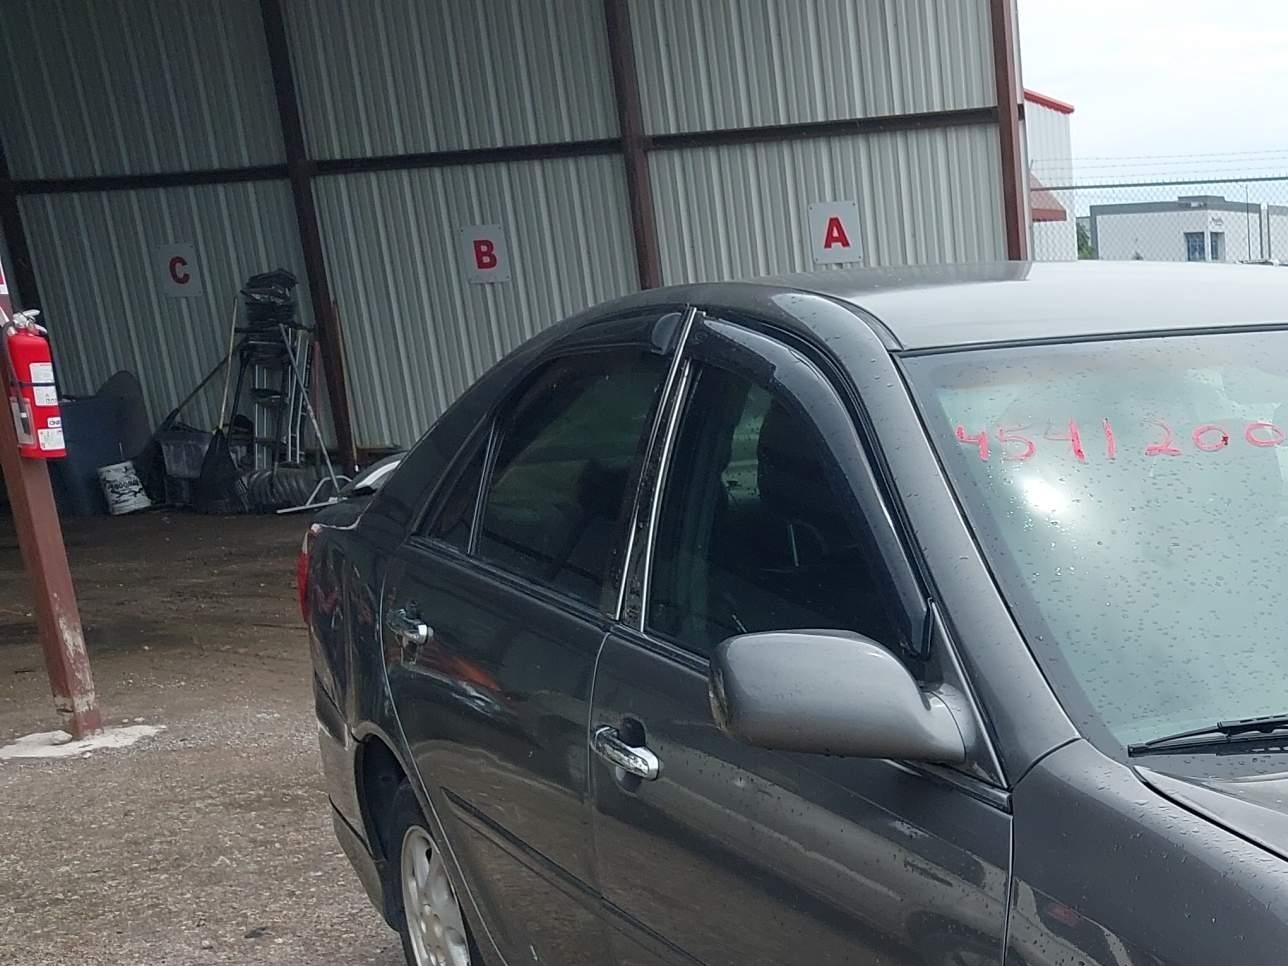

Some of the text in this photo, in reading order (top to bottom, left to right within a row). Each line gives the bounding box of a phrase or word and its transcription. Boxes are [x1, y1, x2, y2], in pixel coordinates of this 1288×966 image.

[822, 214, 850, 250] A
[169, 255, 191, 285] C
[472, 239, 497, 270] B
